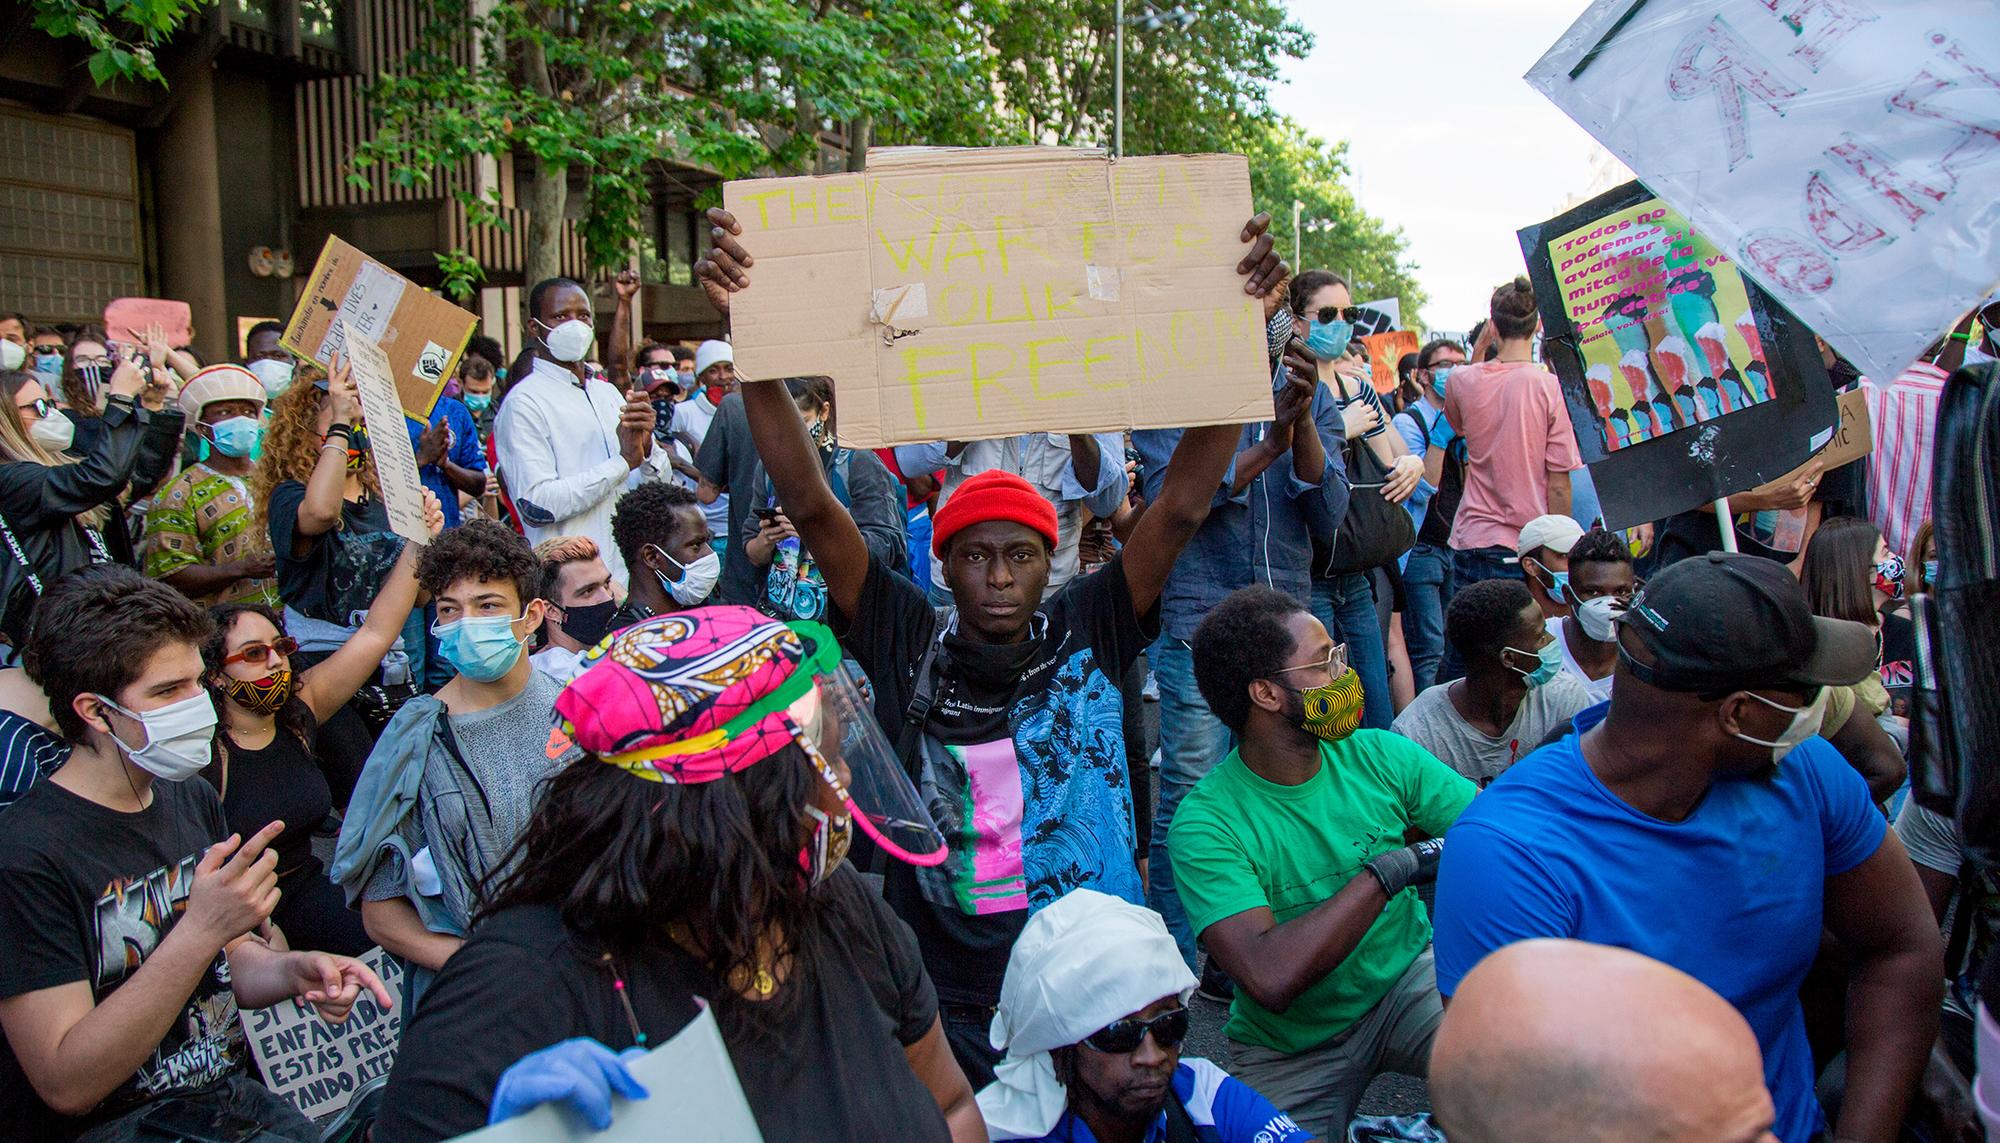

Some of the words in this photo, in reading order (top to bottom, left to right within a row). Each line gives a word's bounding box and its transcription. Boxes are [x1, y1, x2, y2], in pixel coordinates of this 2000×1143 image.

[741, 176, 880, 232] THEY
[1637, 207, 1666, 225] no
[876, 213, 1060, 277] WAR
[1070, 219, 1222, 265] FOR
[1560, 226, 1662, 272] podemos
[1564, 241, 1656, 285] avanzar
[1662, 231, 1683, 245] si
[343, 283, 367, 315] LIVES
[1568, 267, 1631, 301] mitad
[1637, 255, 1665, 274] de
[1671, 244, 1694, 260] la
[1572, 260, 1699, 318] humanidad
[934, 277, 1092, 332] OUR
[1576, 309, 1617, 334] por
[896, 302, 1259, 435] FREEDOM
[956, 700, 973, 711] Latin
[269, 1044, 344, 1088] ESTÁS
